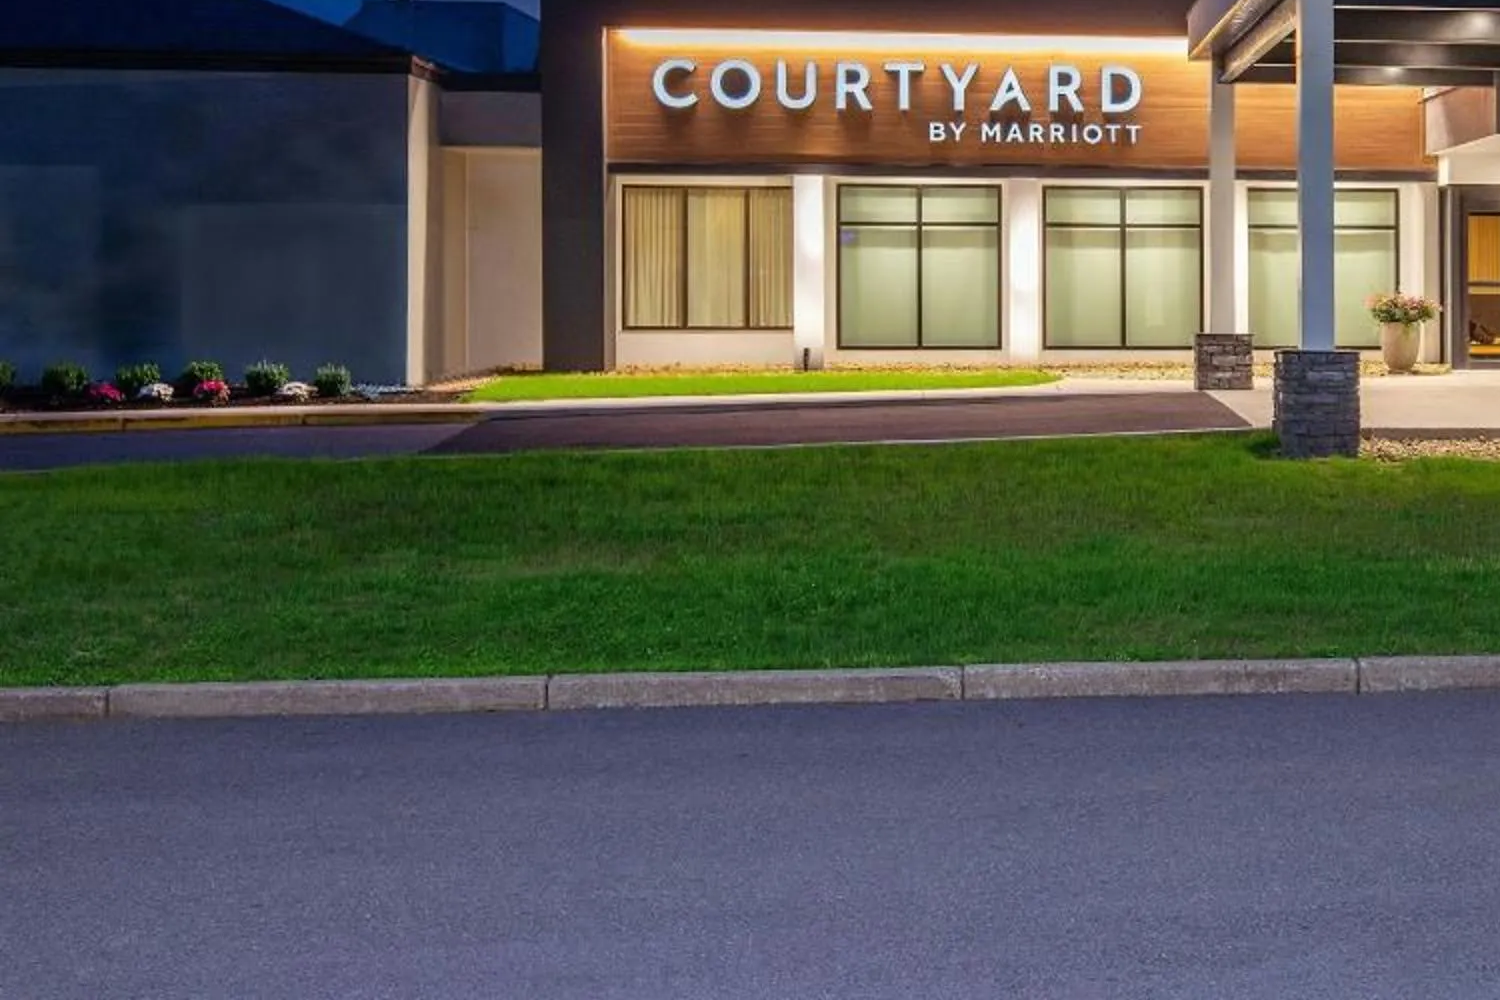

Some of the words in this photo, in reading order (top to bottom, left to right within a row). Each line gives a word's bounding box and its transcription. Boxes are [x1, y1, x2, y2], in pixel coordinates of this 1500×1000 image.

[652, 59, 1142, 112] COURTYARD
[929, 122, 966, 142] BY
[981, 122, 1142, 144] MARRIOTT
